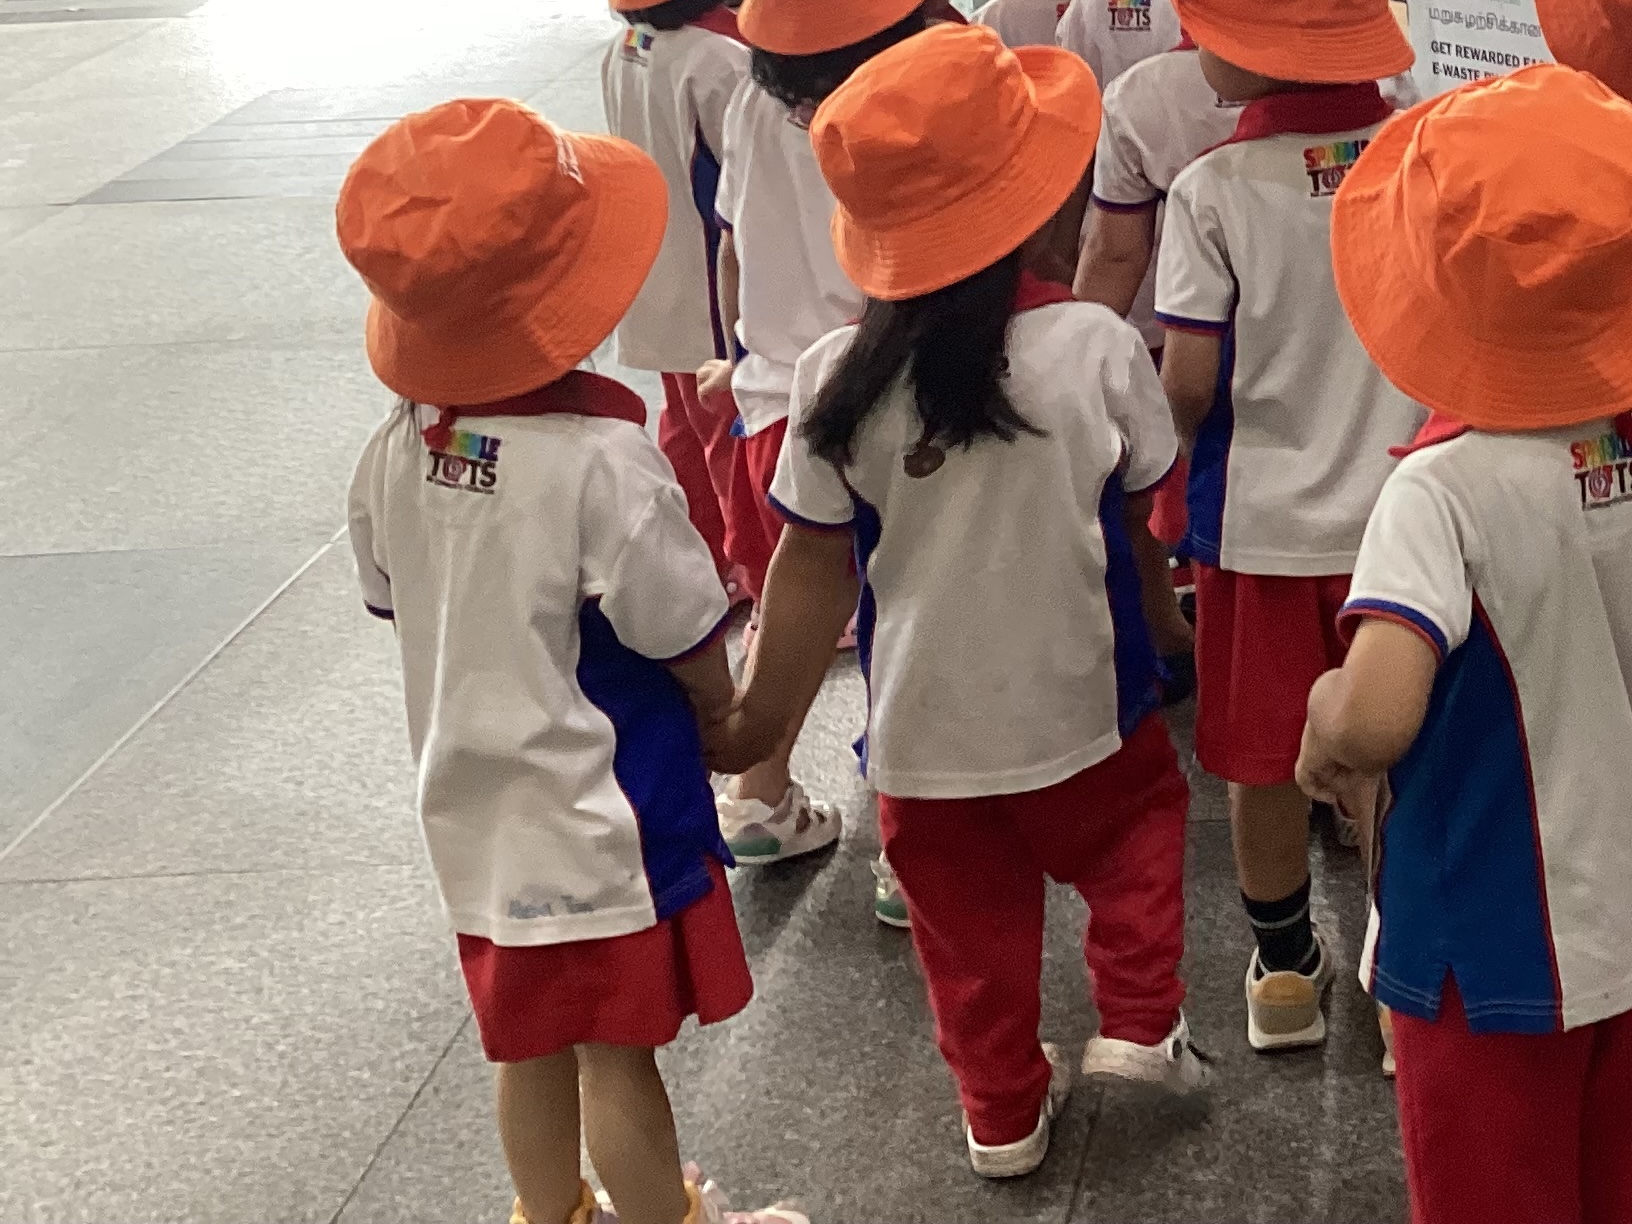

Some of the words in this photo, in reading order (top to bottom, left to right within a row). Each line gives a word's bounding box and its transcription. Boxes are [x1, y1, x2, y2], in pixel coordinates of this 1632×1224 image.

[1431, 40, 1452, 56] GET
[1455, 44, 1520, 67] REWARDED
[1432, 61, 1480, 81] E-WASTE
